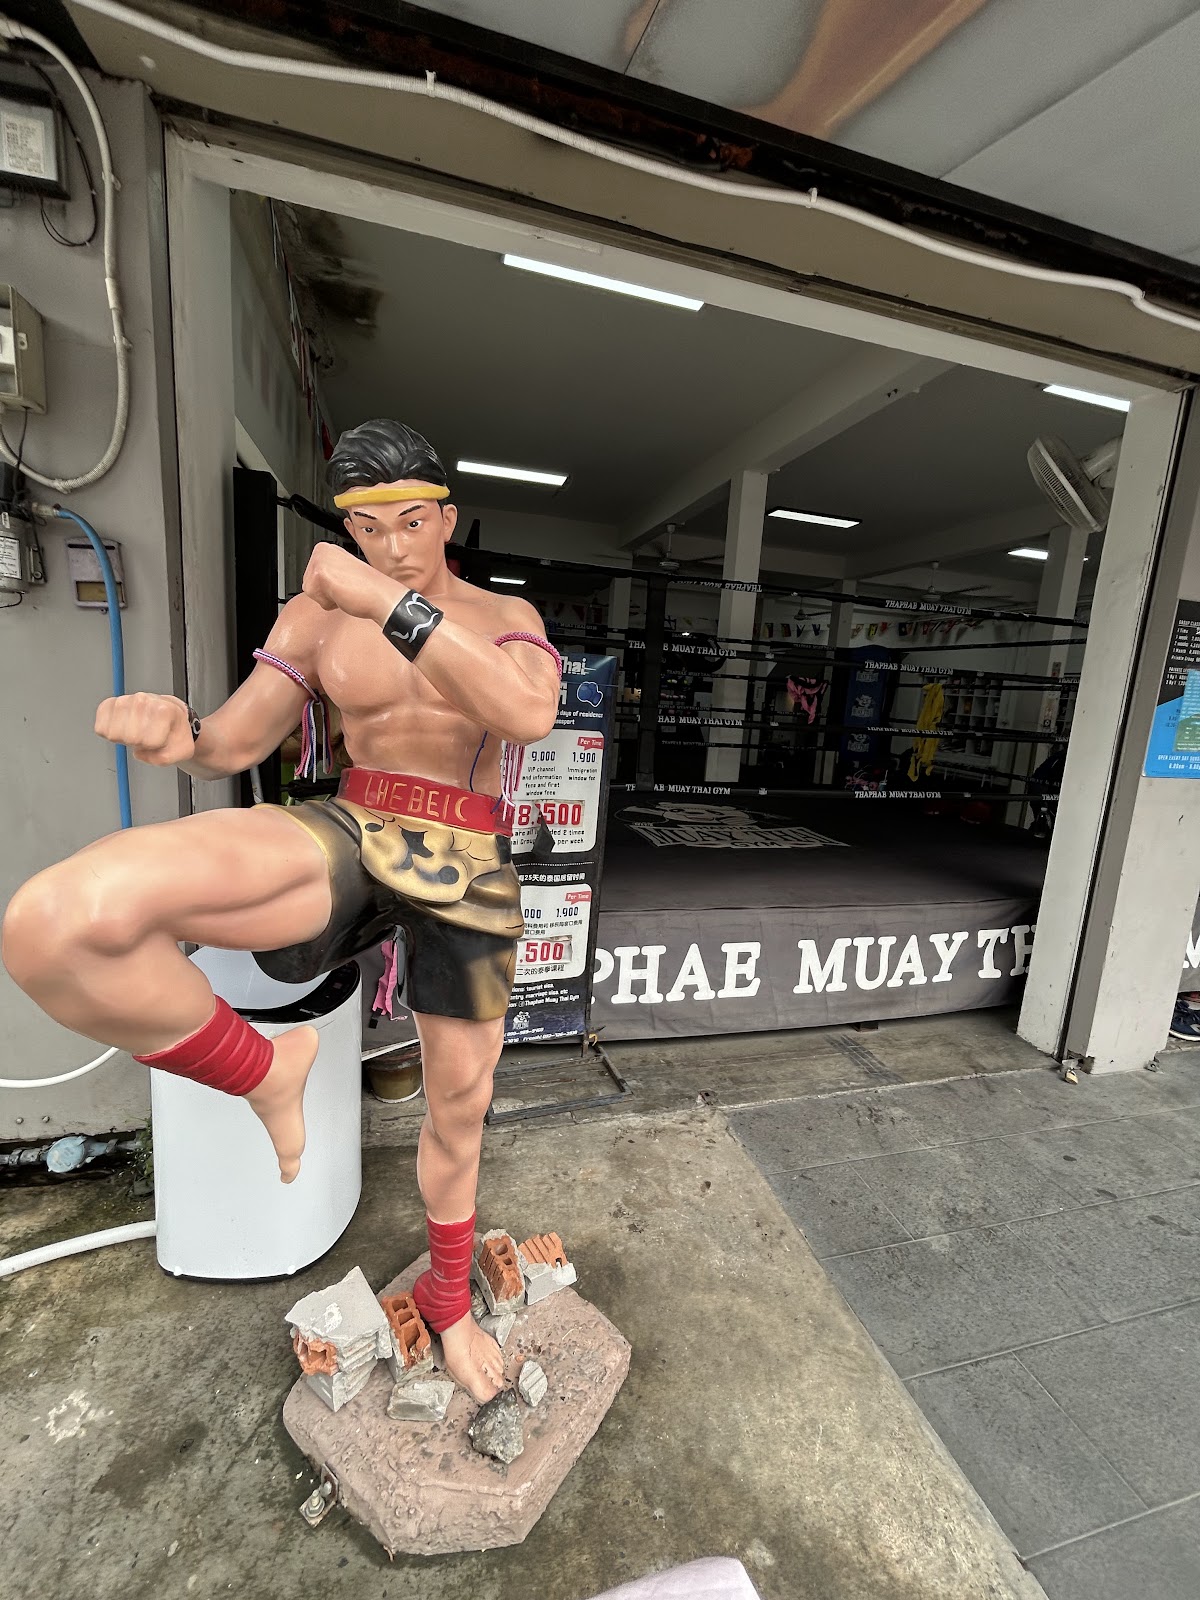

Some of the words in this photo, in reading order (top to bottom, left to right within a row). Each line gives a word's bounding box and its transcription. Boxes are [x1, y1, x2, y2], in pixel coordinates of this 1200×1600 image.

[671, 643, 696, 654] MUAY
[696, 646, 718, 655] THAI
[719, 648, 737, 657] GYM
[679, 716, 703, 725] MUAY
[703, 717, 724, 725] THAI
[724, 718, 743, 726] GYM
[580, 738, 590, 746] Per
[572, 752, 596, 763] 1.900
[668, 784, 691, 793] MUAY
[691, 785, 712, 794] THAI
[712, 786, 731, 795] GYM
[556, 906, 579, 918] 1.900
[793, 931, 969, 994] MUAY
